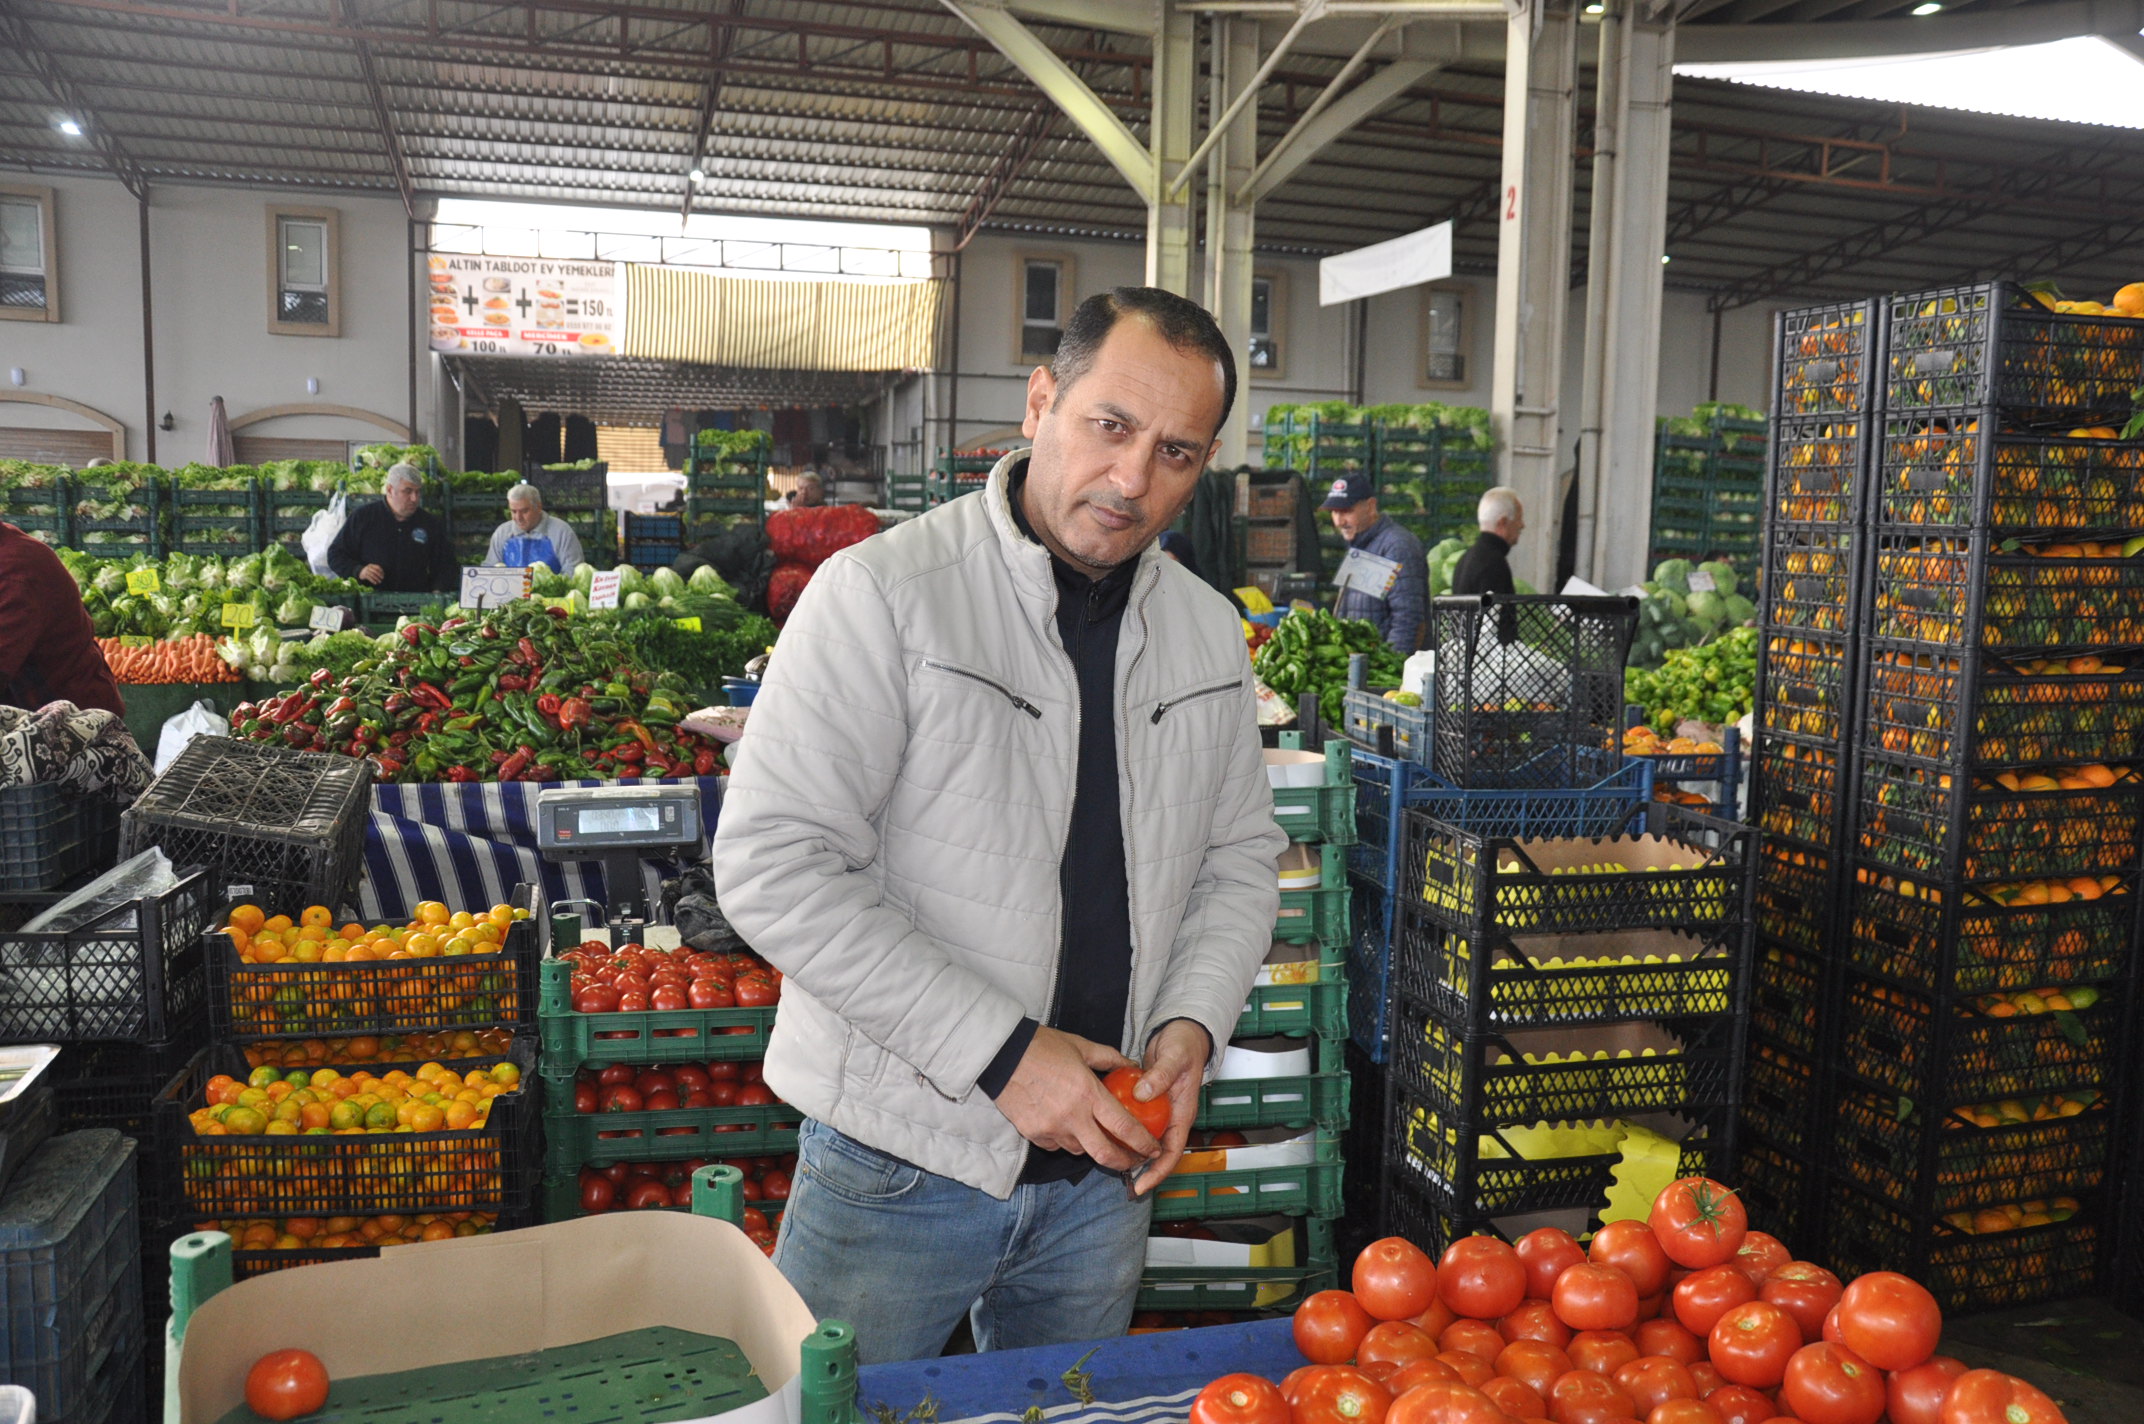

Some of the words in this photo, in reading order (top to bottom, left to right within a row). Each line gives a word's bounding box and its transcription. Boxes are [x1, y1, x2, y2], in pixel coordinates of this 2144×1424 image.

[1506, 185, 1517, 221] 2
[449, 259, 481, 271] ALTIN
[485, 260, 537, 274] TABLDOT
[541, 263, 554, 275] EV
[582, 299, 604, 316] 150
[472, 340, 496, 352] 100
[533, 342, 557, 355] 70
[225, 604, 251, 625] 20
[313, 607, 340, 629] 20
